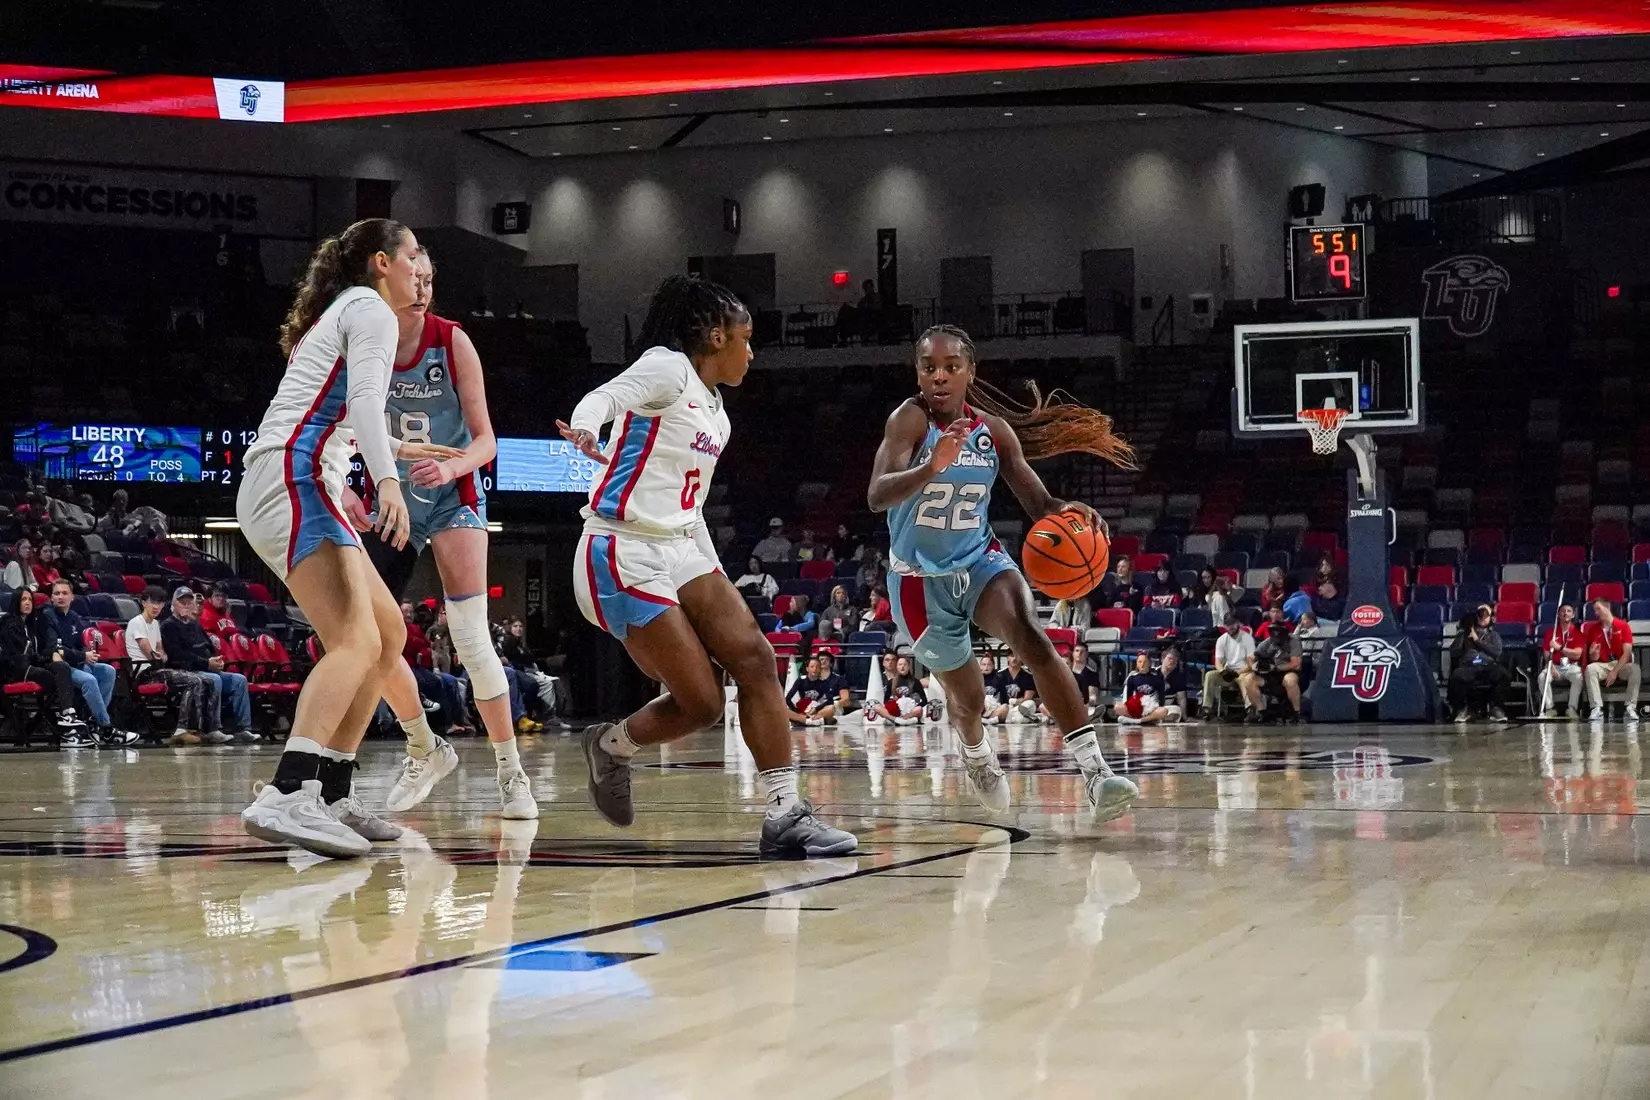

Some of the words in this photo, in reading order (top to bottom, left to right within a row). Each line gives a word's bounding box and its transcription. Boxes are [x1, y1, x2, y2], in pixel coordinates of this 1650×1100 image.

[56, 83, 99, 99] ARENA
[5, 181, 258, 221] CONCESSIONS
[1329, 254, 1352, 289] 9
[72, 426, 146, 443] LIBERTY
[222, 430, 232, 445] 0
[93, 444, 125, 469] 48
[205, 452, 213, 462] F
[150, 460, 183, 471] POSS
[568, 458, 595, 482] 33
[126, 471, 133, 482] 0
[177, 473, 184, 482] 4
[201, 471, 217, 481] PT
[221, 470, 232, 484] 2
[483, 476, 492, 491] 0
[915, 482, 987, 531] 22
[1350, 508, 1383, 518] SPALDING
